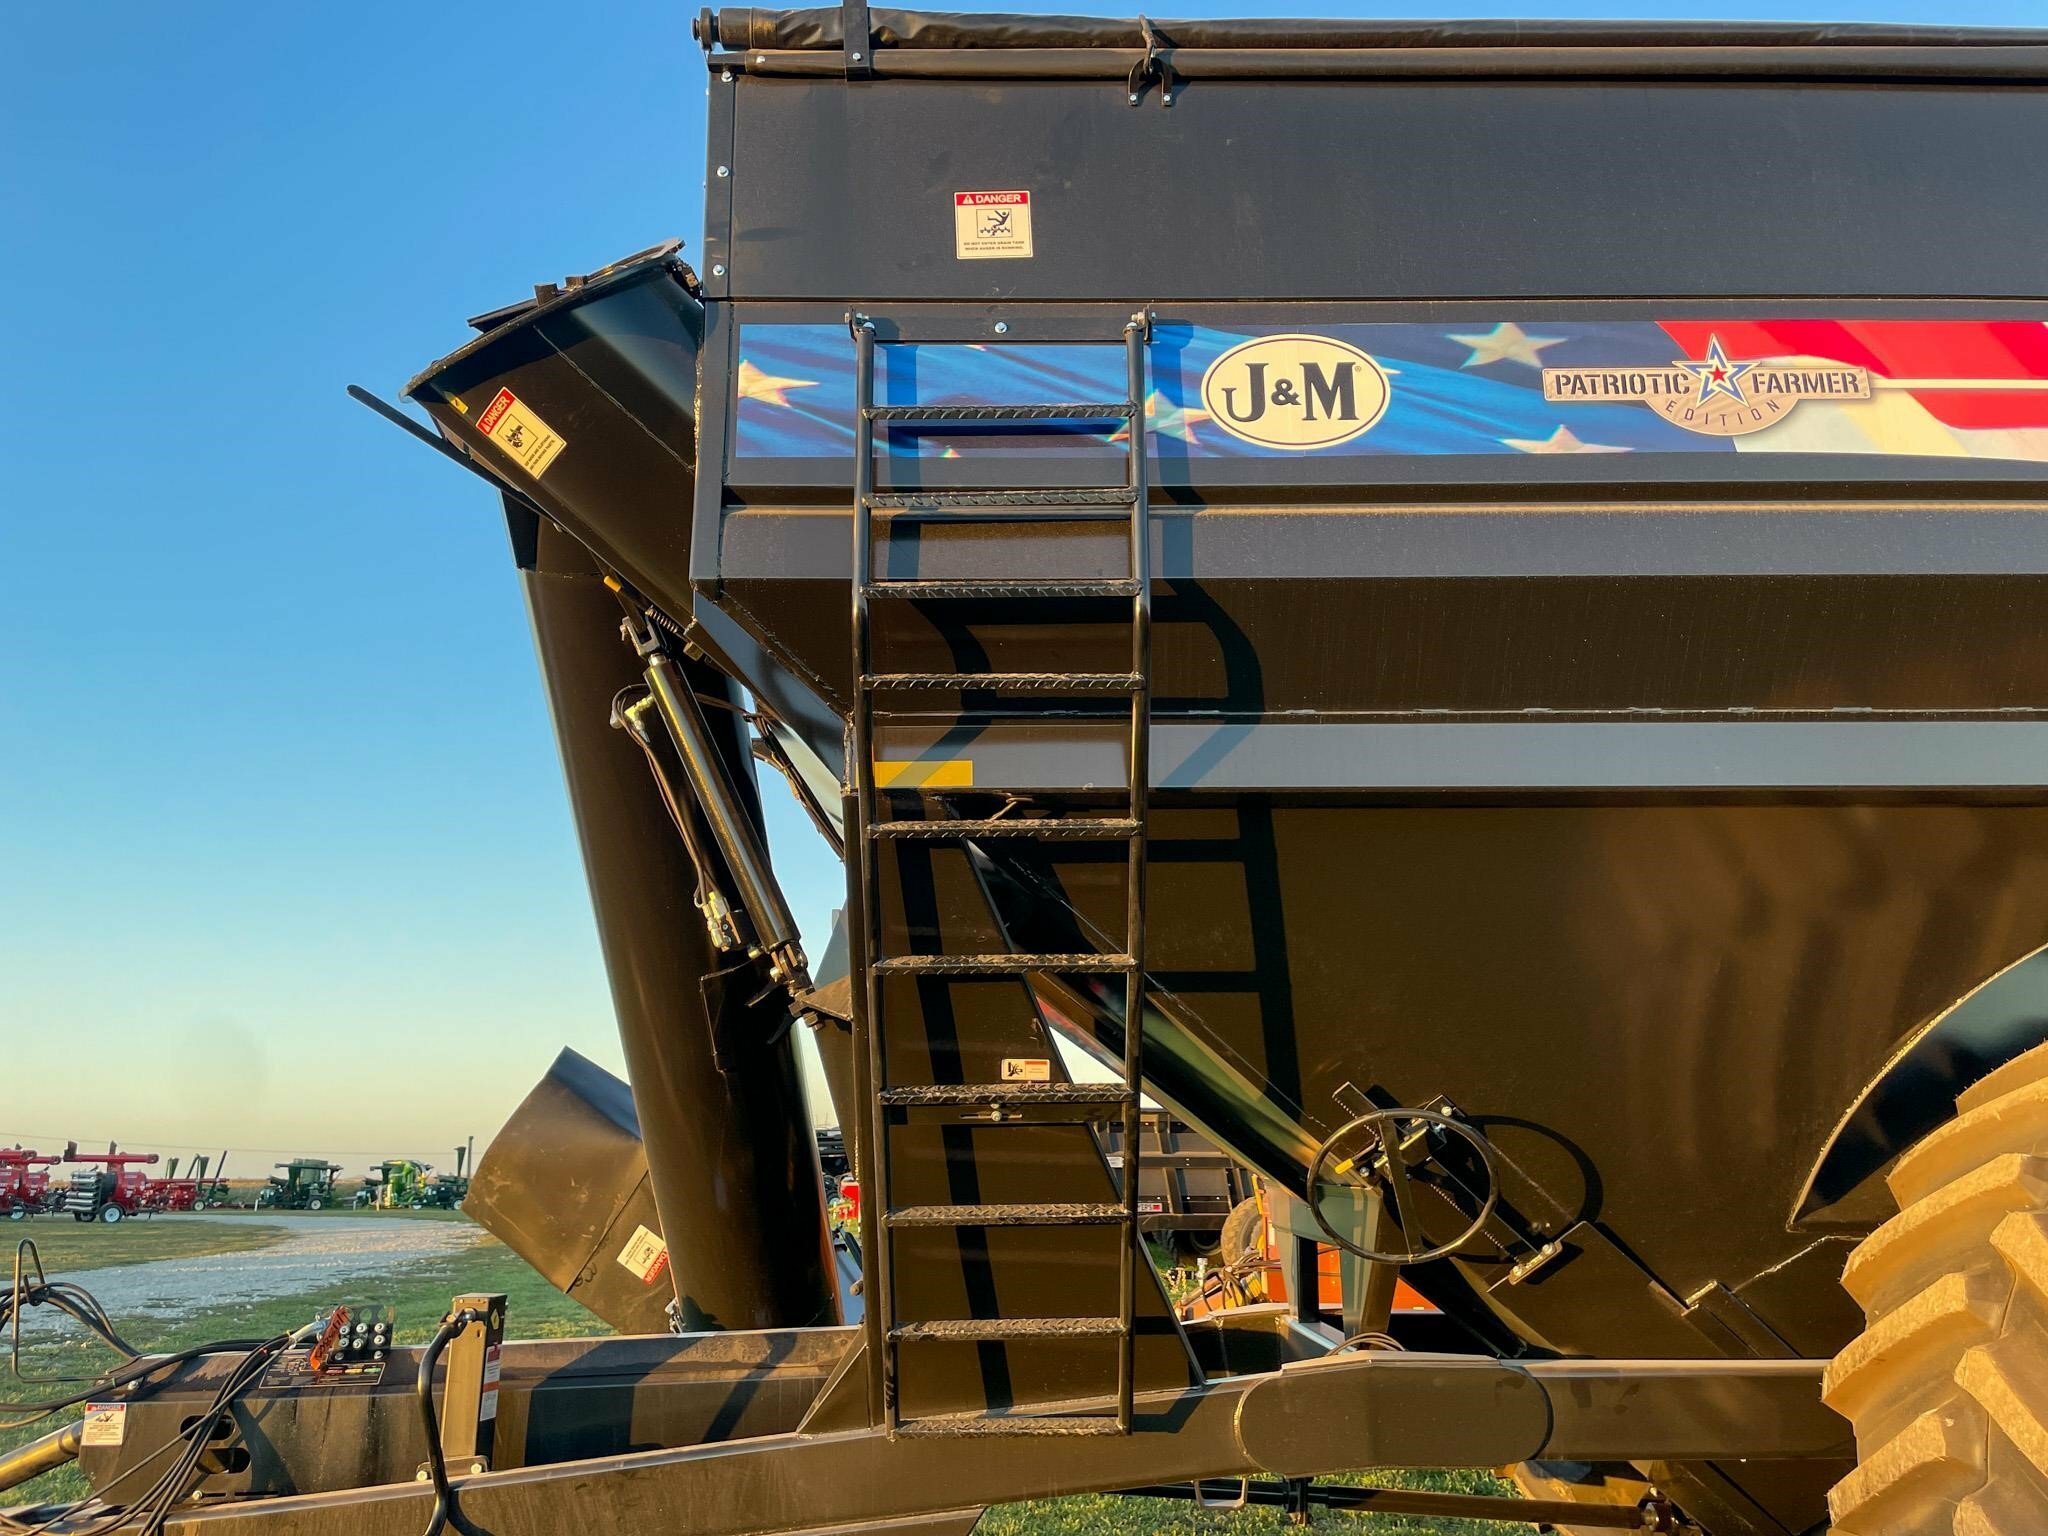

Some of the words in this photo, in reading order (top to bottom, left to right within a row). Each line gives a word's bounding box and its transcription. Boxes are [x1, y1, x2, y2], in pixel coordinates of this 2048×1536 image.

[975, 194, 1022, 204] DANGER
[1221, 362, 1360, 423] J&M
[1555, 373, 1690, 395] PATRIOTIC
[1752, 372, 1860, 394] FARMER
[484, 395, 511, 426] DANGER
[1665, 399, 1781, 427] EDITION
